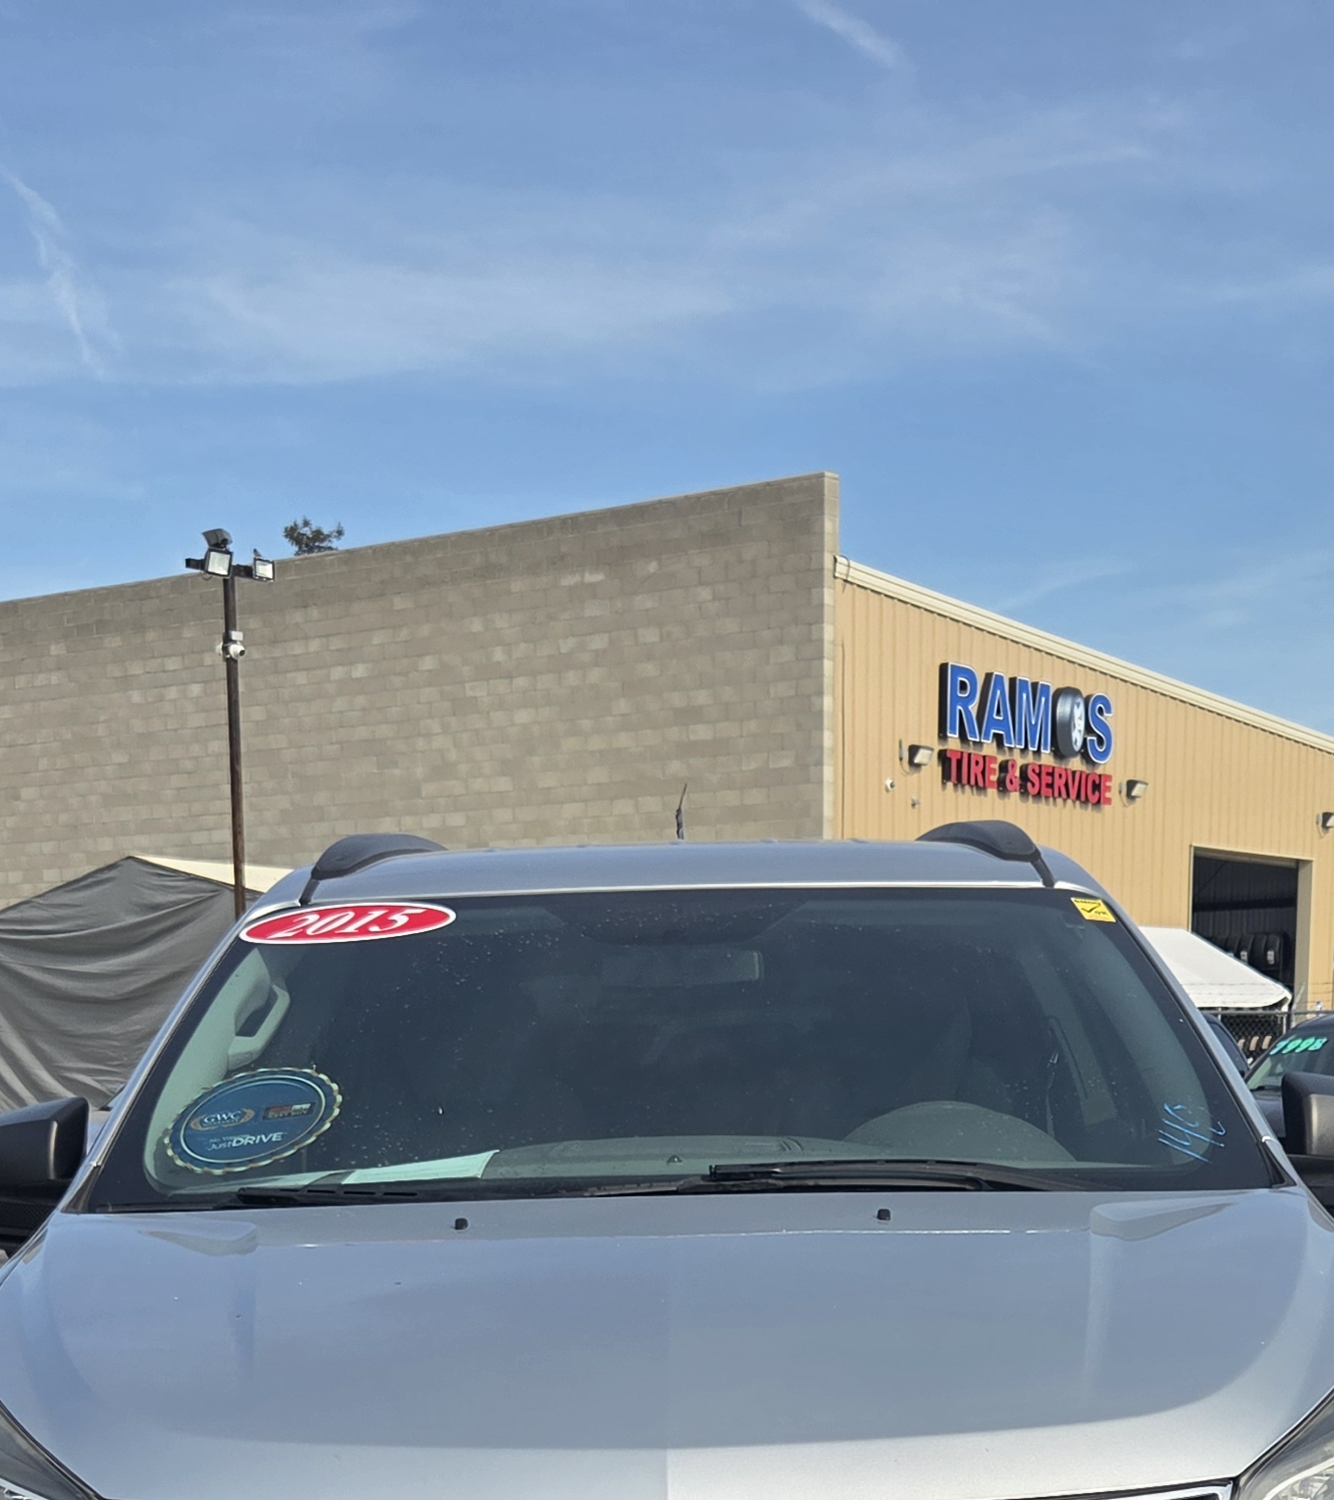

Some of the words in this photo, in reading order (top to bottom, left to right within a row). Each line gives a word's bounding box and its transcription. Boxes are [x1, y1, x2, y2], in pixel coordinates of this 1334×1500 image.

[946, 749, 997, 789] TIRE
[1005, 758, 1020, 792] &
[1027, 762, 1113, 805] SERVICE
[267, 909, 427, 939] 2015
